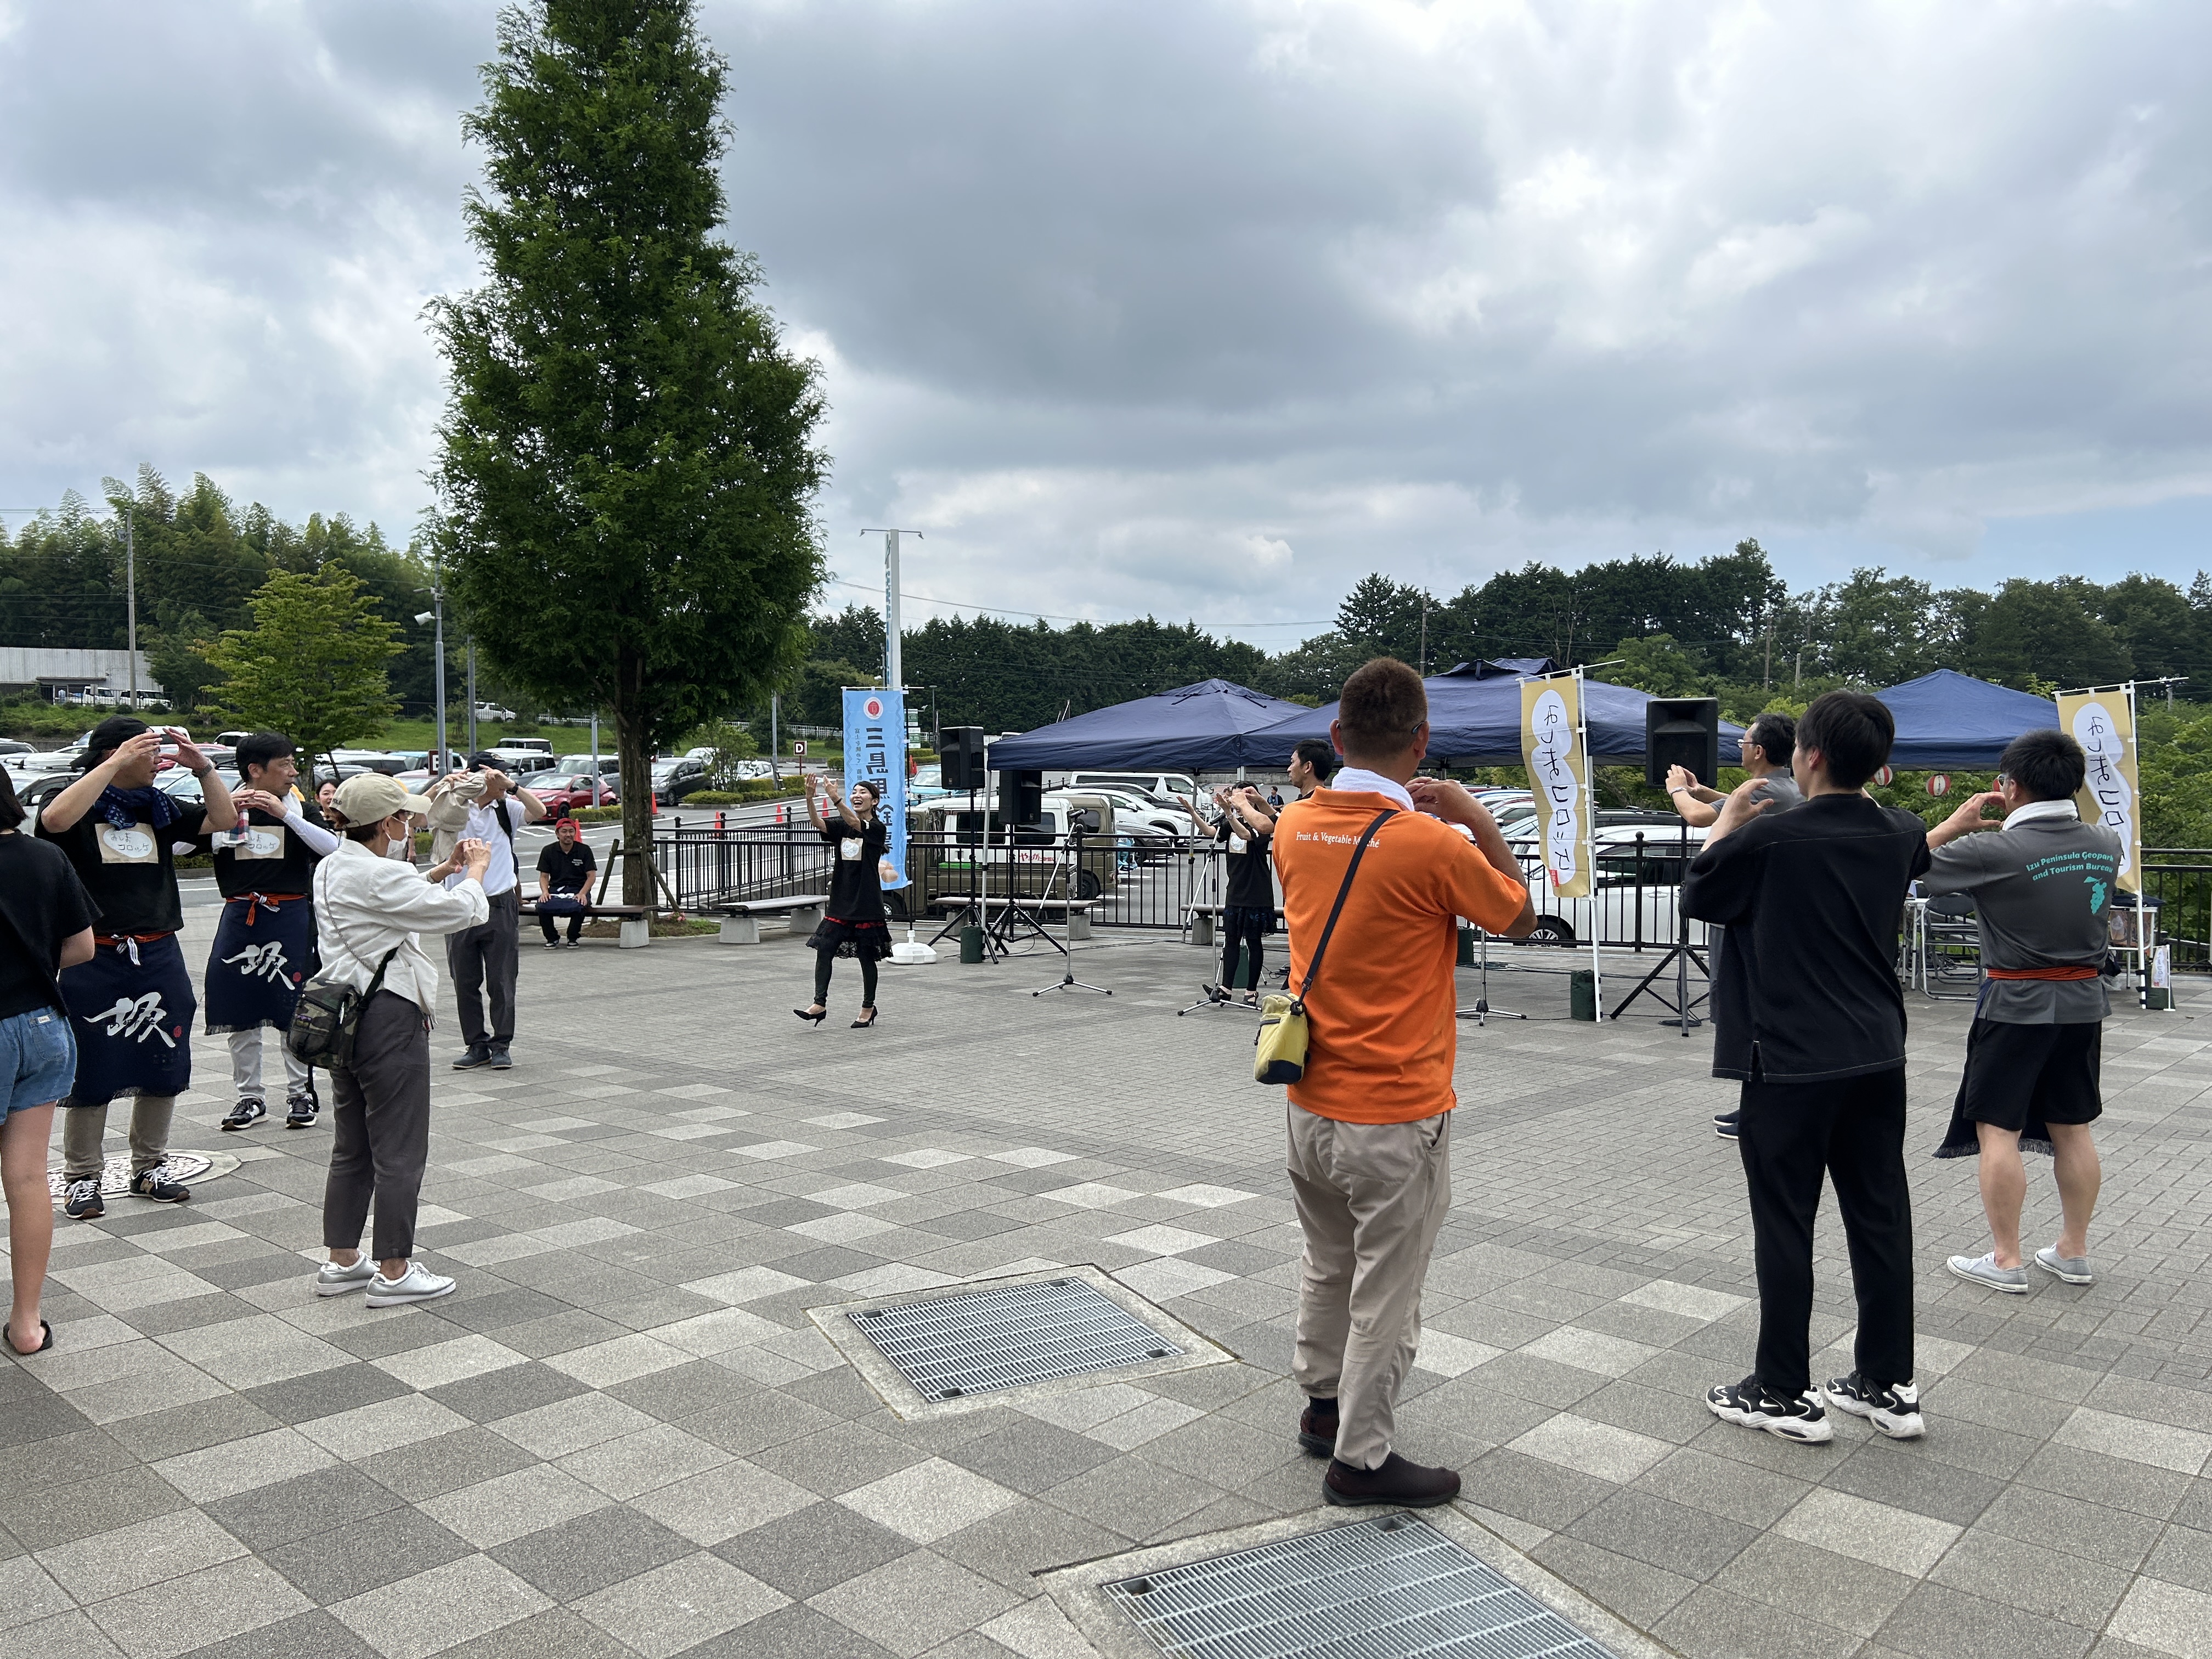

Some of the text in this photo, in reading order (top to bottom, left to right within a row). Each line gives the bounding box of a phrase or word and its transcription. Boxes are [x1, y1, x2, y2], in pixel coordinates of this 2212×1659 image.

[795, 743, 804, 753] D
[1296, 831, 1380, 848] Fruit & Vegetable Mché
[2025, 851, 2114, 872] Izu Peninsula Geopark
[2032, 862, 2113, 881] and Tourism Bureau
